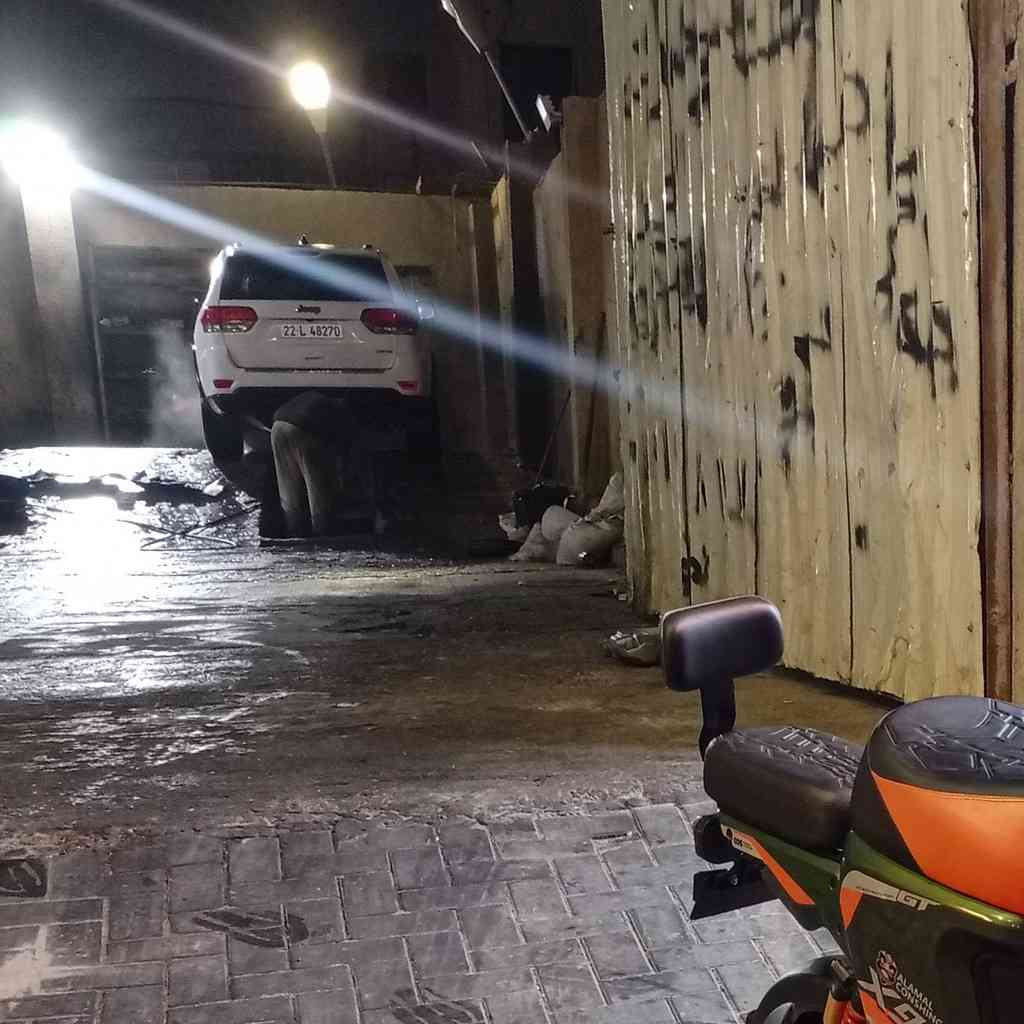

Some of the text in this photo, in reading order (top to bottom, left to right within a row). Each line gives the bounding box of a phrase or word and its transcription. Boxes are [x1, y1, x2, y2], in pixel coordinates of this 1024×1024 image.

[283, 326, 296, 337] 22
[299, 326, 306, 337] L
[897, 890, 941, 911] GT
[897, 974, 933, 1011] ALAMAL
